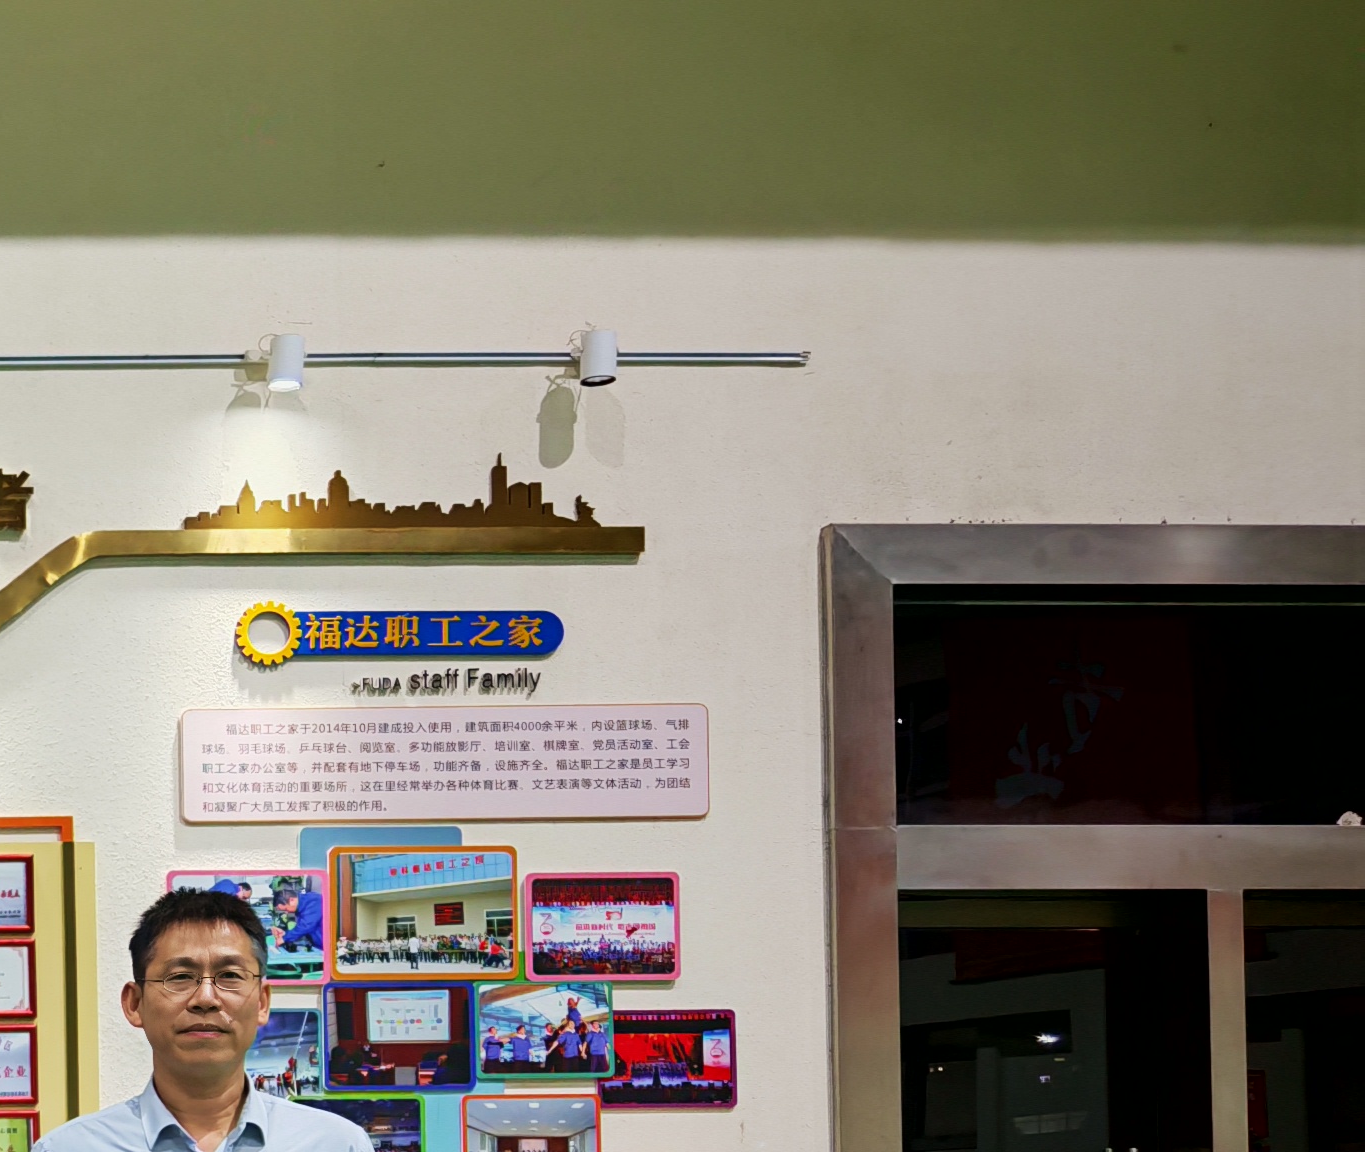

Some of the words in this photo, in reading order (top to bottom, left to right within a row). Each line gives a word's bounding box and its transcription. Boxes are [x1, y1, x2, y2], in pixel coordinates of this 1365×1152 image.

[304, 612, 545, 650] 福达职工之家
[360, 677, 402, 690] FUDA
[409, 669, 459, 690] staff
[467, 667, 541, 693] Family
